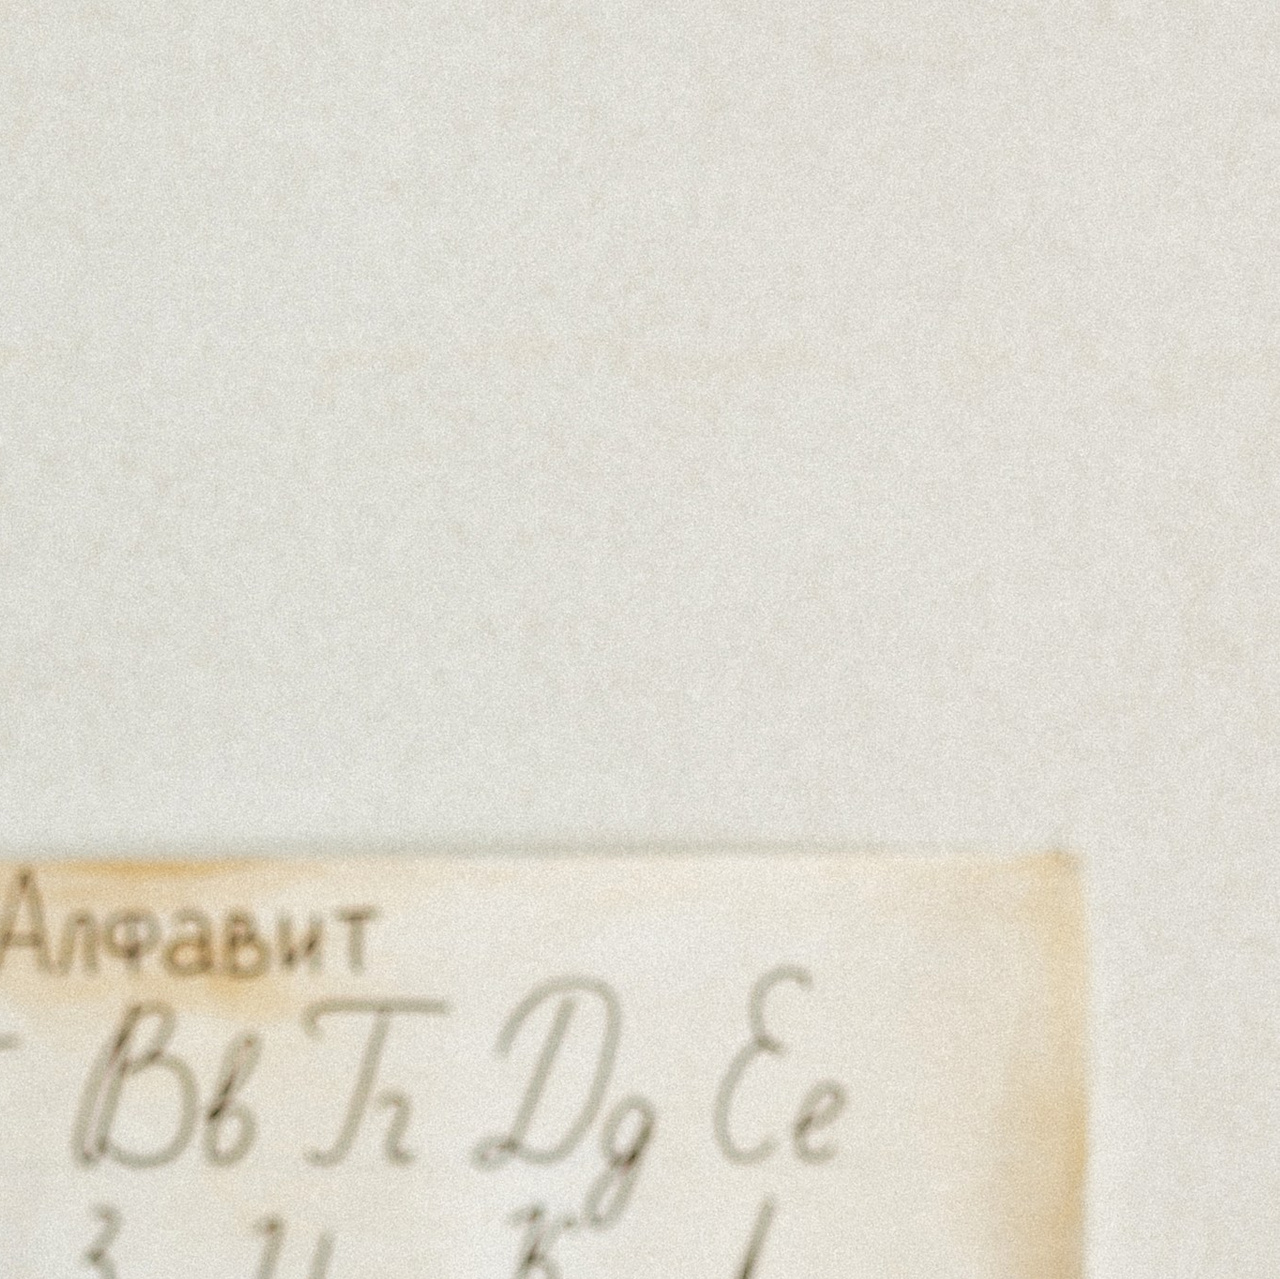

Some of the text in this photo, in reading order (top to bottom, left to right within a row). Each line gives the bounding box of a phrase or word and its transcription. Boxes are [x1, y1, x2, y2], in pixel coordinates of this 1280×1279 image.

[71, 998, 262, 1169] Вв
[303, 1000, 451, 1167] Гг
[714, 964, 846, 1167] Ее
